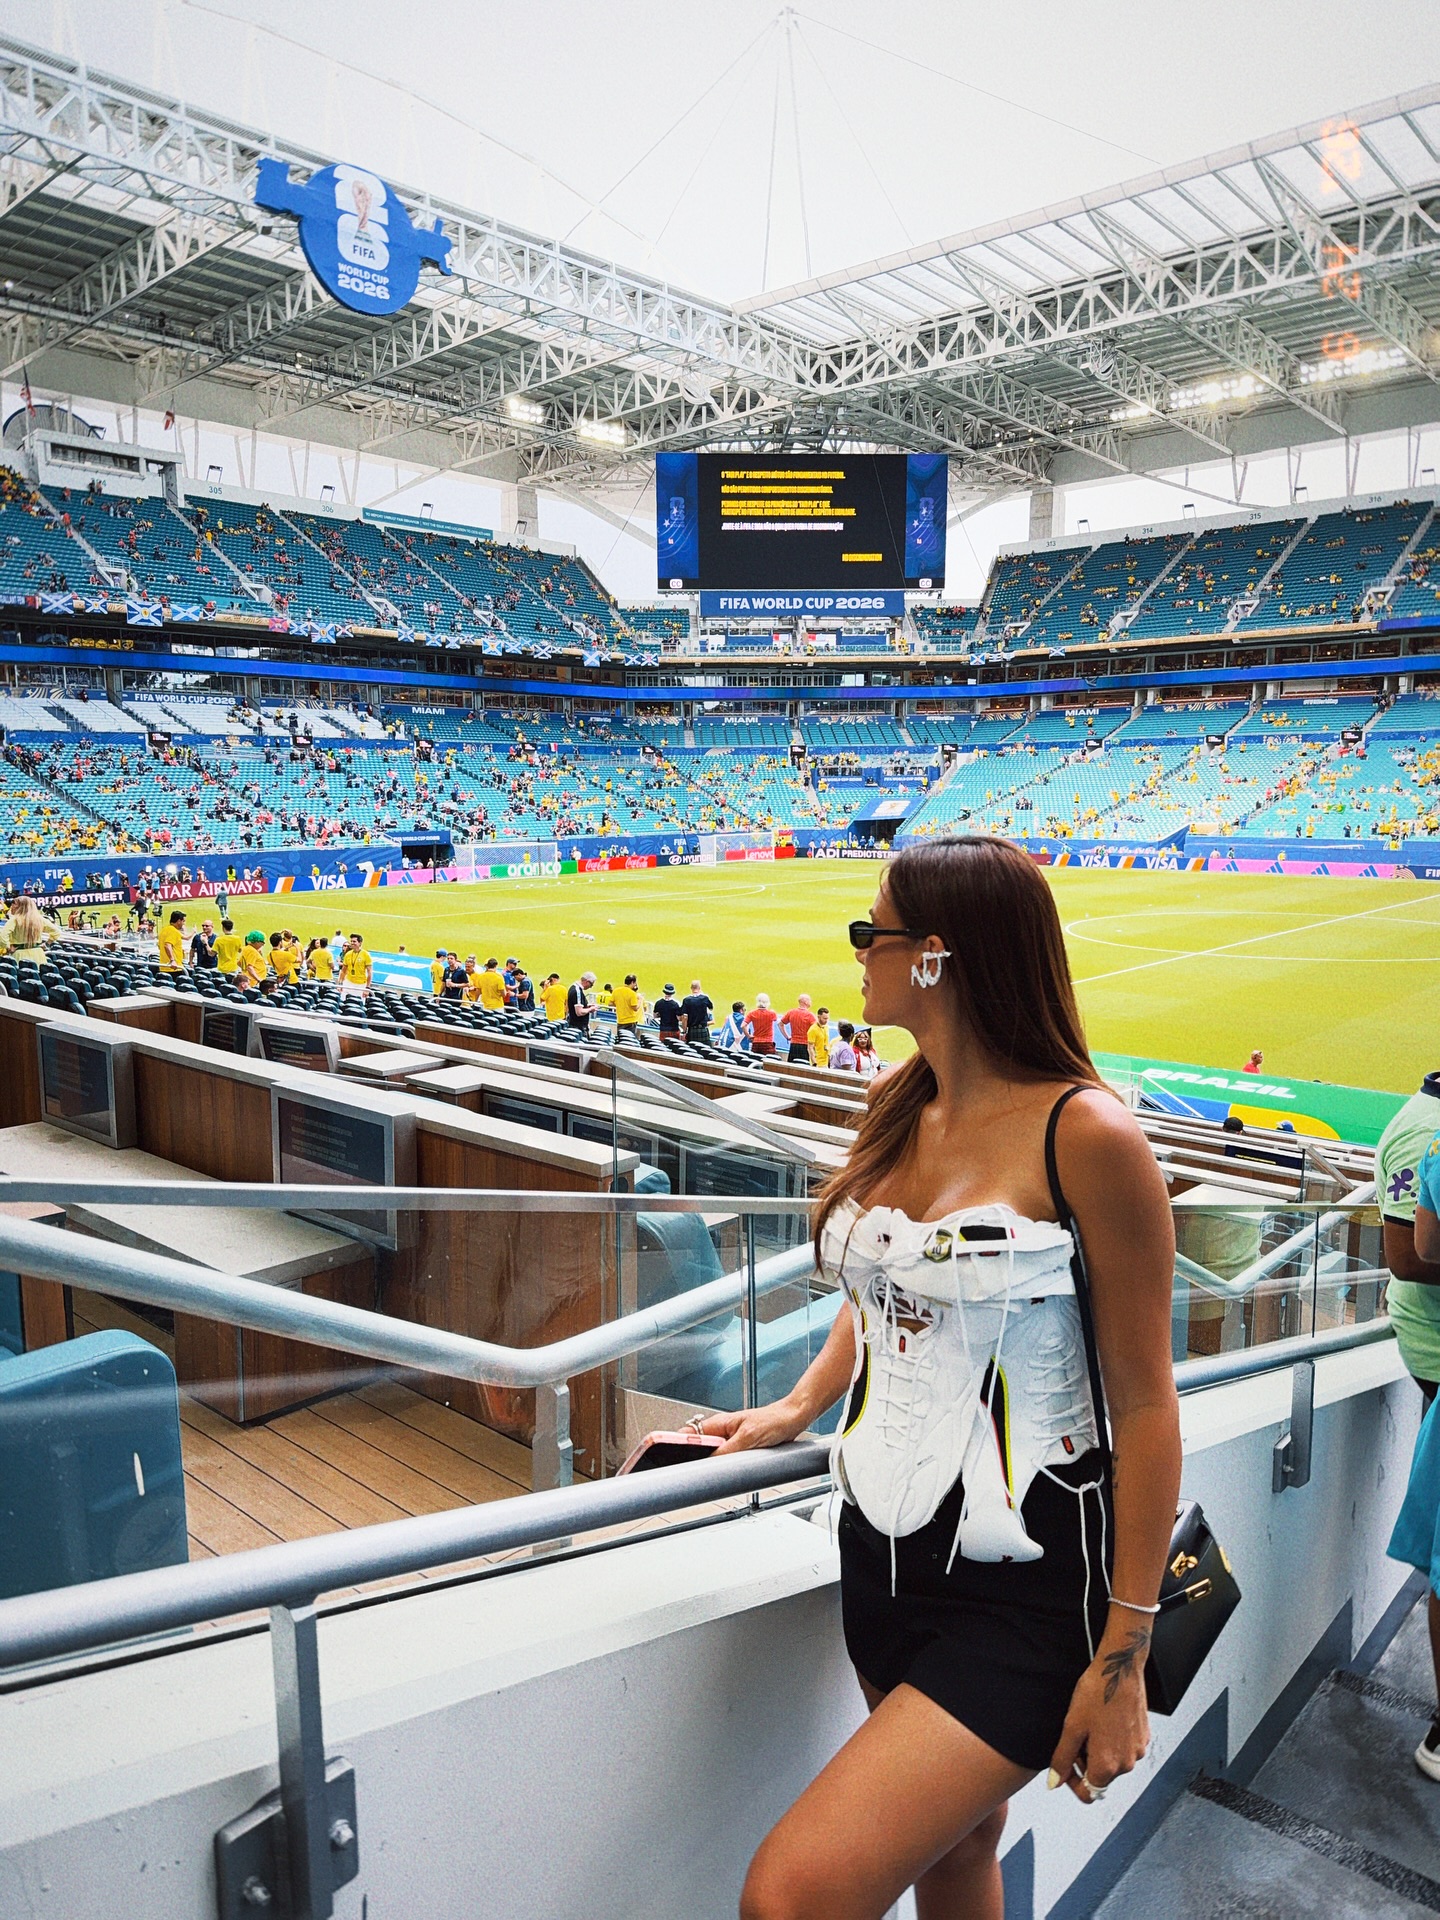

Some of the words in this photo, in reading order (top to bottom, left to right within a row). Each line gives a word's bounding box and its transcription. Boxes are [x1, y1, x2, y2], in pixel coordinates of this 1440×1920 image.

[352, 244, 376, 261] FIFA
[338, 262, 370, 281] WORLD
[371, 271, 390, 286] CUP
[337, 273, 390, 300] 2026
[208, 486, 223, 495] 305
[321, 504, 335, 513] 306
[1249, 513, 1262, 521] 315
[1142, 527, 1154, 535] 314
[1045, 540, 1057, 548] 313
[719, 597, 750, 610] FIFA
[752, 597, 803, 610] WORLD
[805, 597, 834, 610] CUP
[835, 597, 885, 609] 2026
[134, 693, 155, 702] FIFA
[155, 694, 187, 704] WORLD
[188, 696, 206, 705] CUP
[206, 696, 236, 706] 2026
[411, 706, 446, 716] MIAMI
[1065, 708, 1100, 717] MIAMI
[673, 837, 687, 846] FIFA
[814, 848, 840, 859] ADI
[507, 860, 562, 876] aramco
[1078, 855, 1111, 868] VISA
[1143, 856, 1179, 870] VISA
[45, 868, 74, 880] FIFA
[308, 874, 347, 891] VISA
[145, 884, 193, 900] ATAR
[198, 879, 263, 897] AIRWAYS
[1142, 1068, 1297, 1099] BRAZIL
